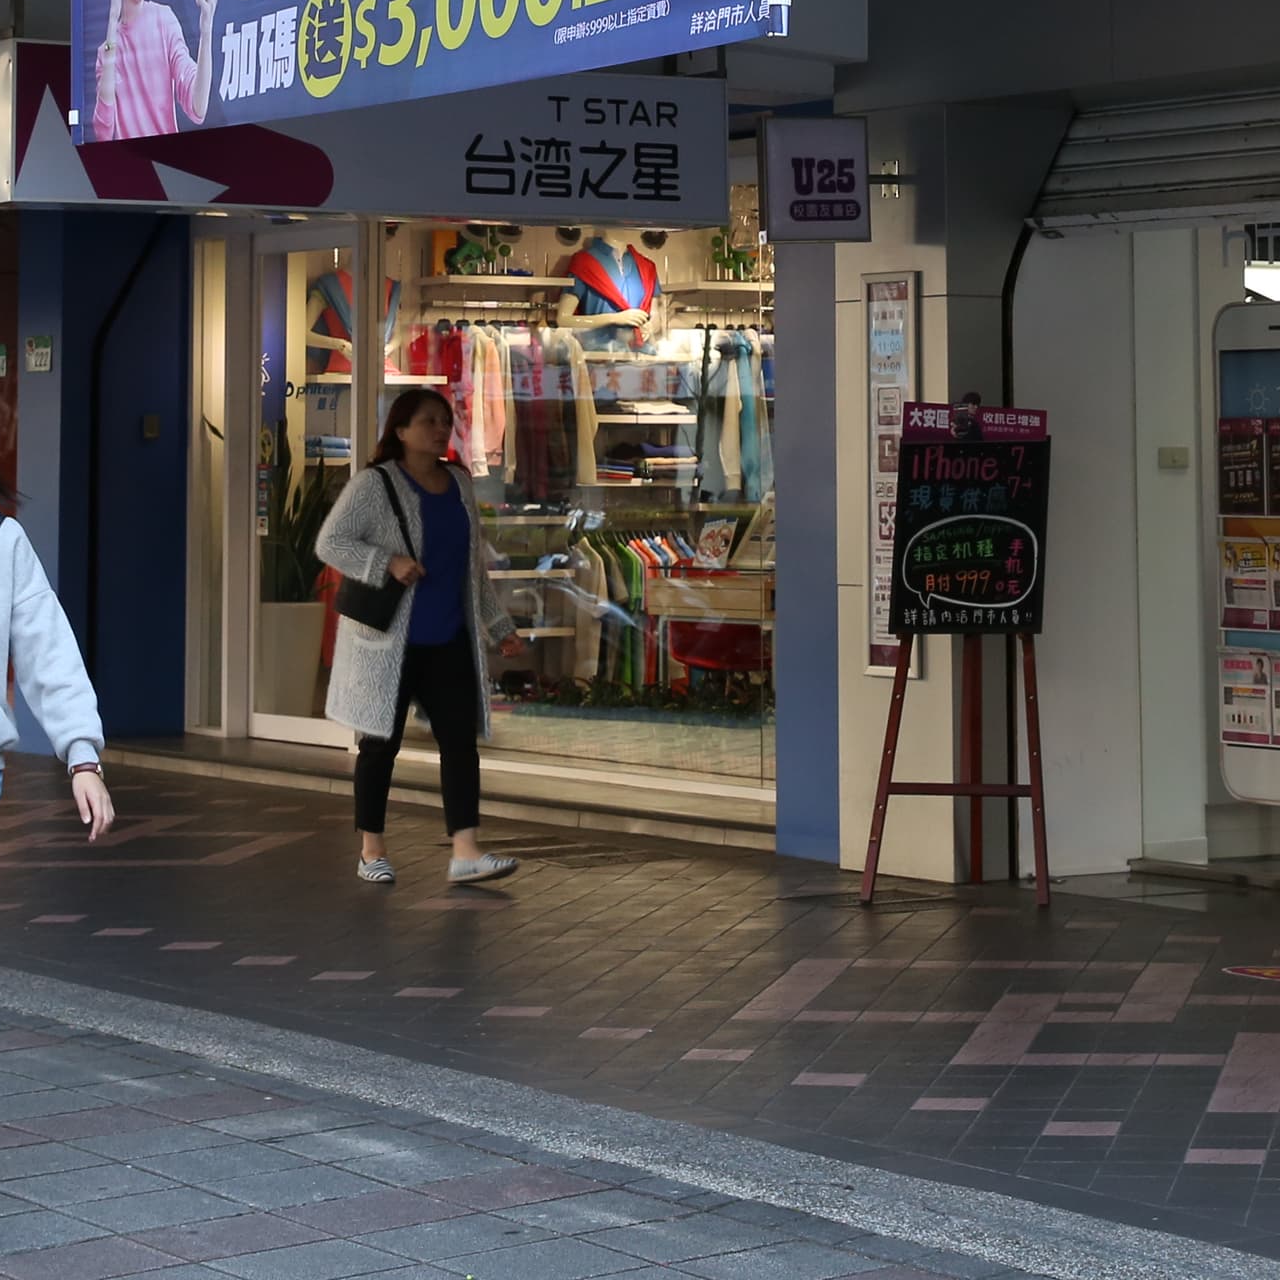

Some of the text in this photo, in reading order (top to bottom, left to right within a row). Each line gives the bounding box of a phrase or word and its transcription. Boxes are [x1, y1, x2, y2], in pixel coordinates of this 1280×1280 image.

[547, 95, 677, 127] T STAR
[791, 157, 856, 196] U25
[909, 408, 950, 429] 大安區
[912, 446, 1025, 480] iPhone 7
